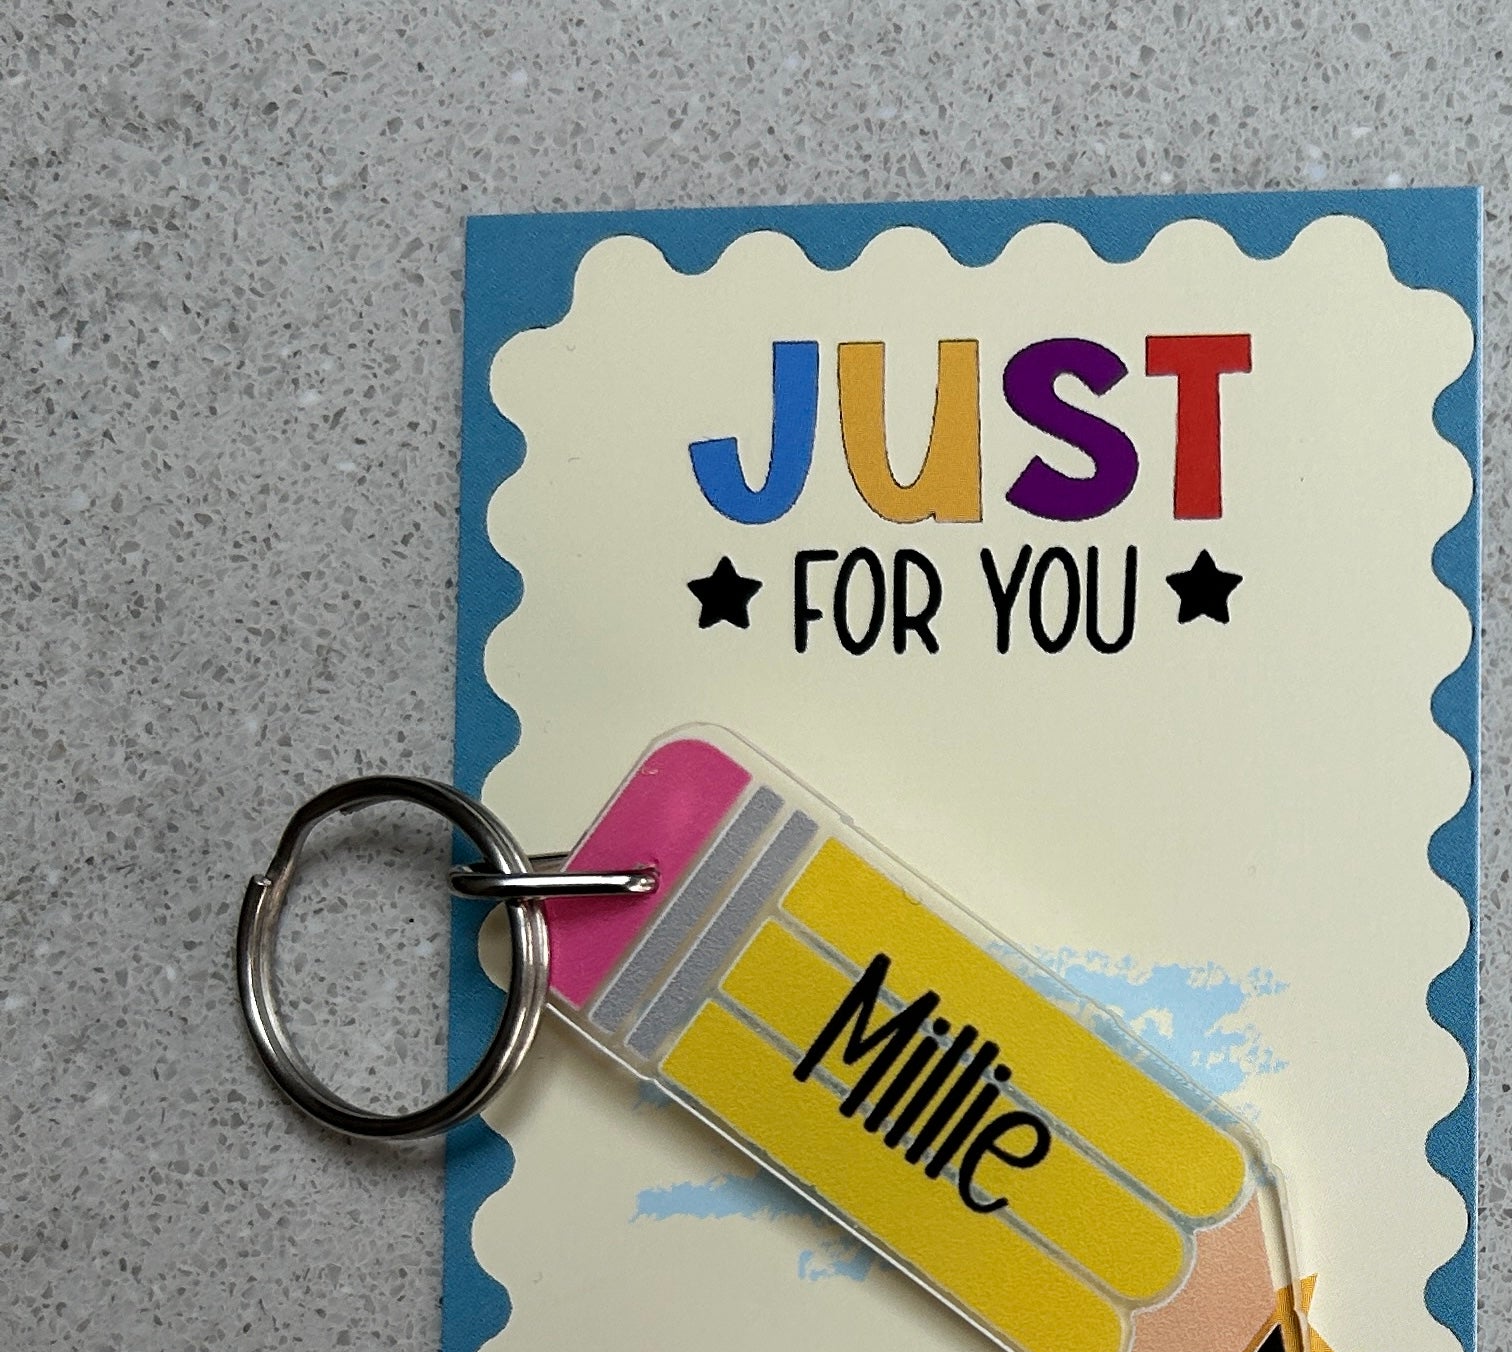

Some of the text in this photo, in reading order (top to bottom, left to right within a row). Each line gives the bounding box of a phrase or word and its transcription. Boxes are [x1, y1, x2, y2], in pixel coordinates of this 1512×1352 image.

[688, 334, 1253, 525] JUST
[794, 544, 1138, 656] FOR YOU
[793, 953, 1051, 1213] Millie
